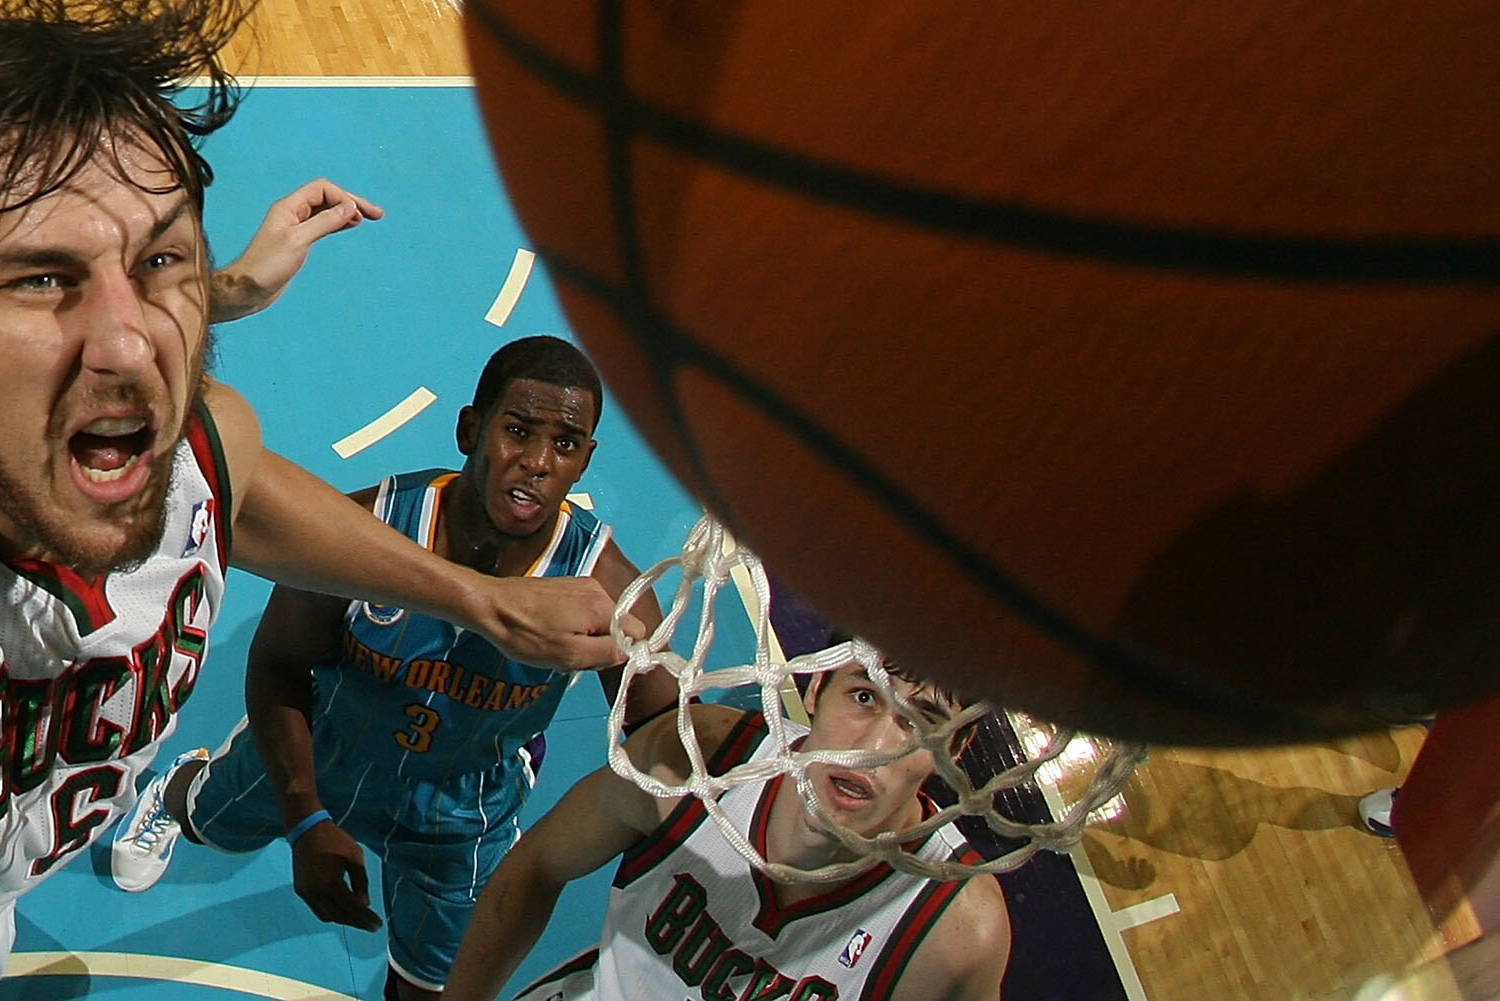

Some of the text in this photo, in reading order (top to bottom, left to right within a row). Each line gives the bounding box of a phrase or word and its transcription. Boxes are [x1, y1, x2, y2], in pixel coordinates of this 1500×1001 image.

[342, 629, 550, 713] NEW ORLEANS
[394, 702, 442, 754] 3
